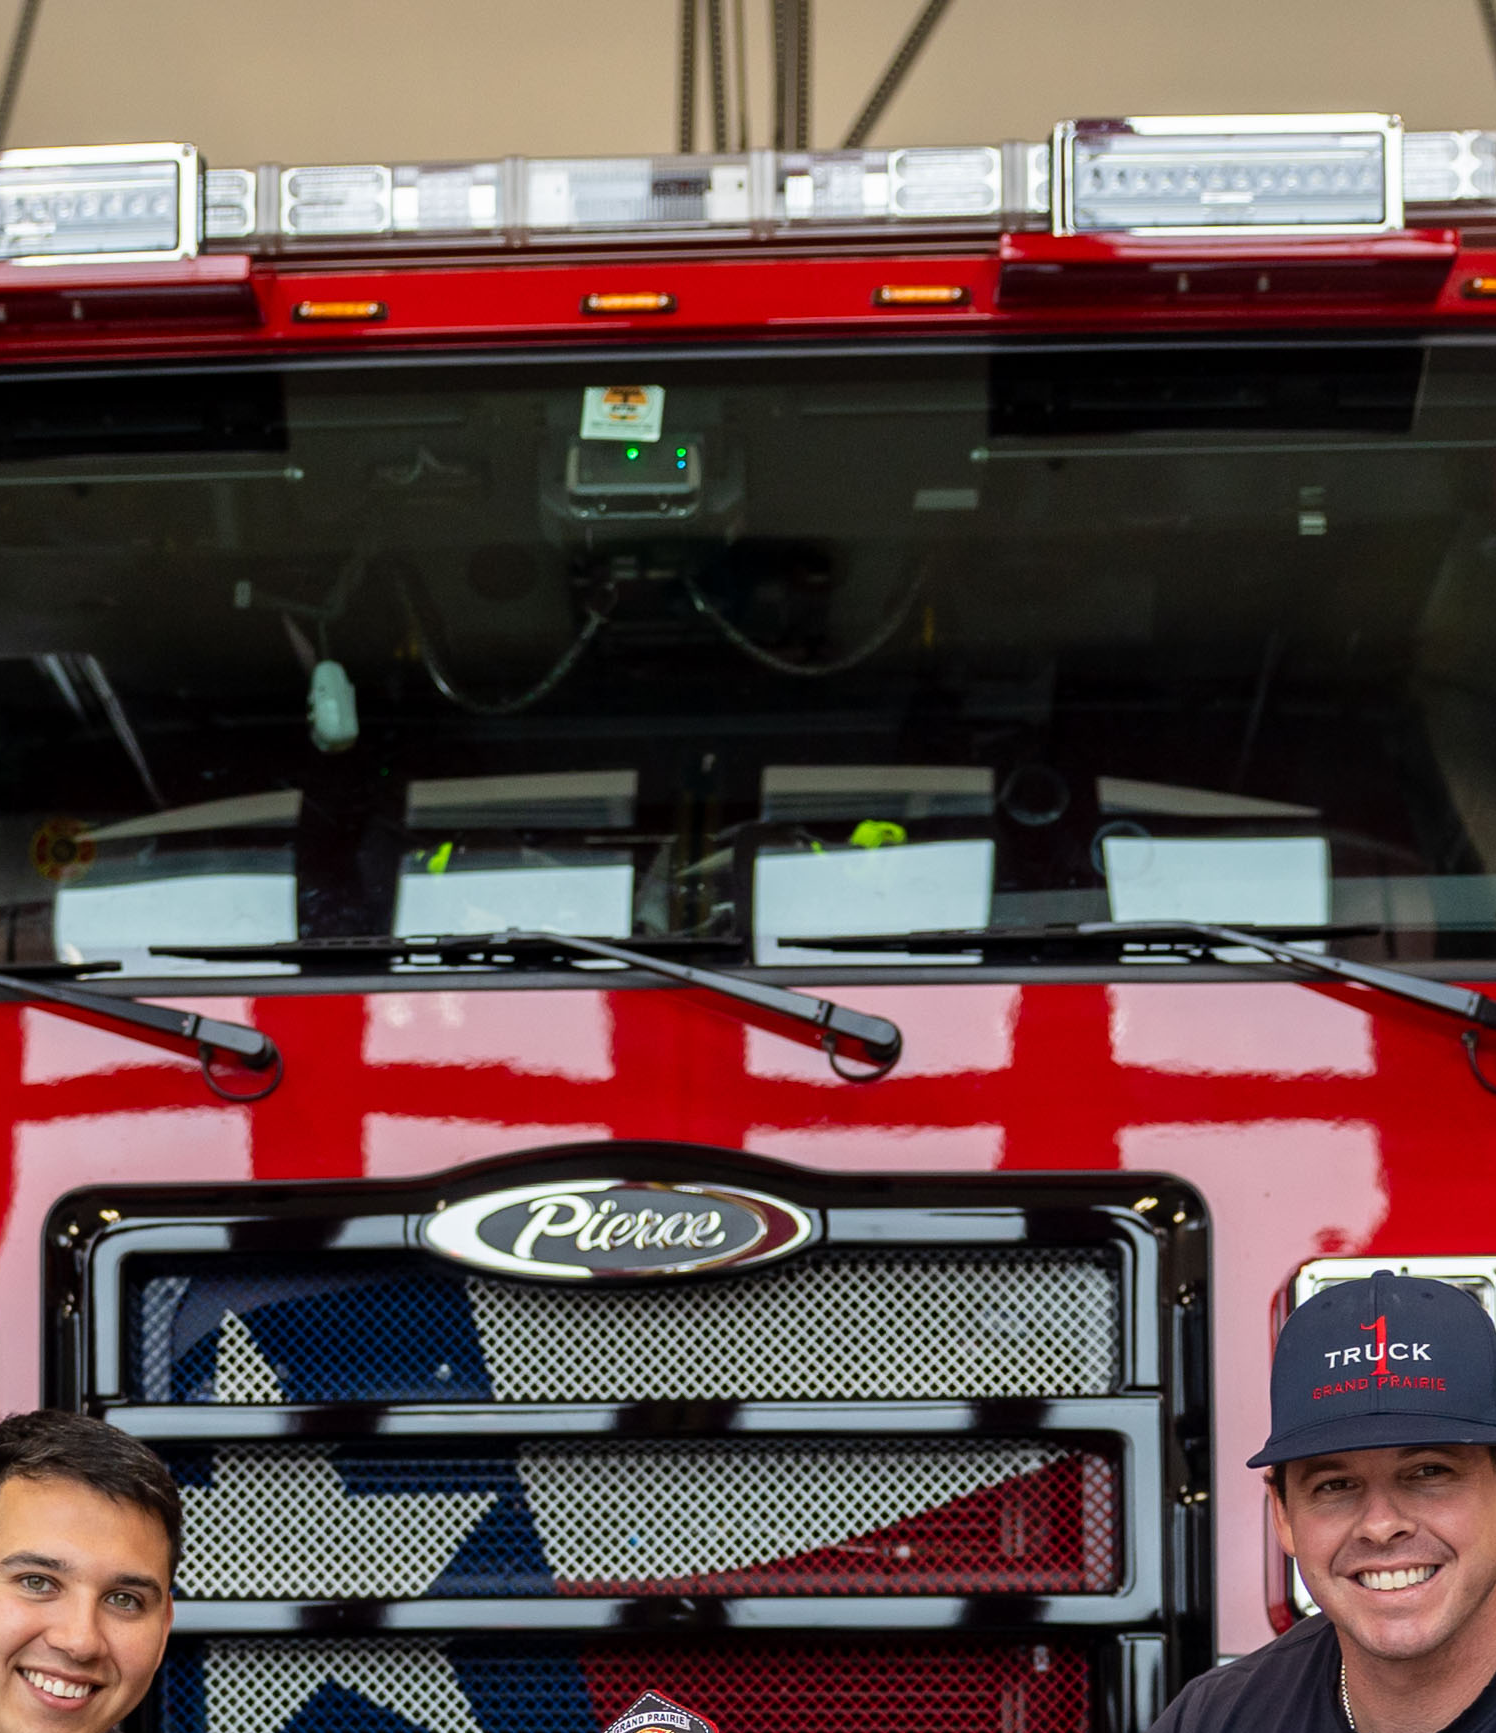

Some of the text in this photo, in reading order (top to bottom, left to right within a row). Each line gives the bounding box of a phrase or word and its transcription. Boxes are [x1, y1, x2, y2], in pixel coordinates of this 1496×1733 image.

[512, 1194, 726, 1259] Pierce
[1325, 1343, 1432, 1369] TRUCK
[1312, 1376, 1447, 1400] GRAND PRAIRIE
[647, 1713, 685, 1725] PRAIRIE
